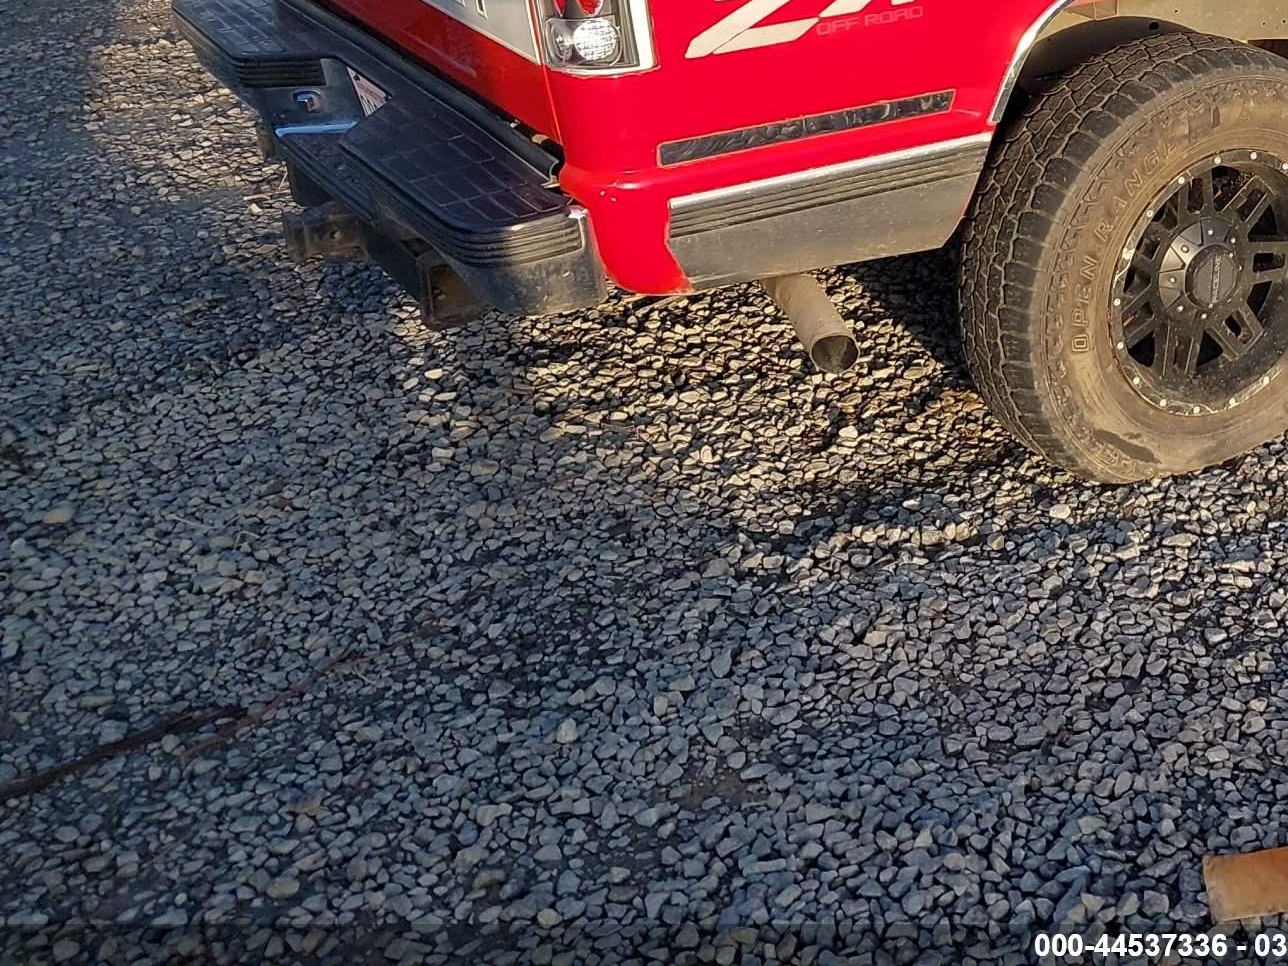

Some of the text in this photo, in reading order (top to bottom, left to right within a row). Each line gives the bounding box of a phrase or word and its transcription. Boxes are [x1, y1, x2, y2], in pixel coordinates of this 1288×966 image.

[815, 5, 924, 36] OFF ROAD
[1071, 255, 1099, 354] OPEN
